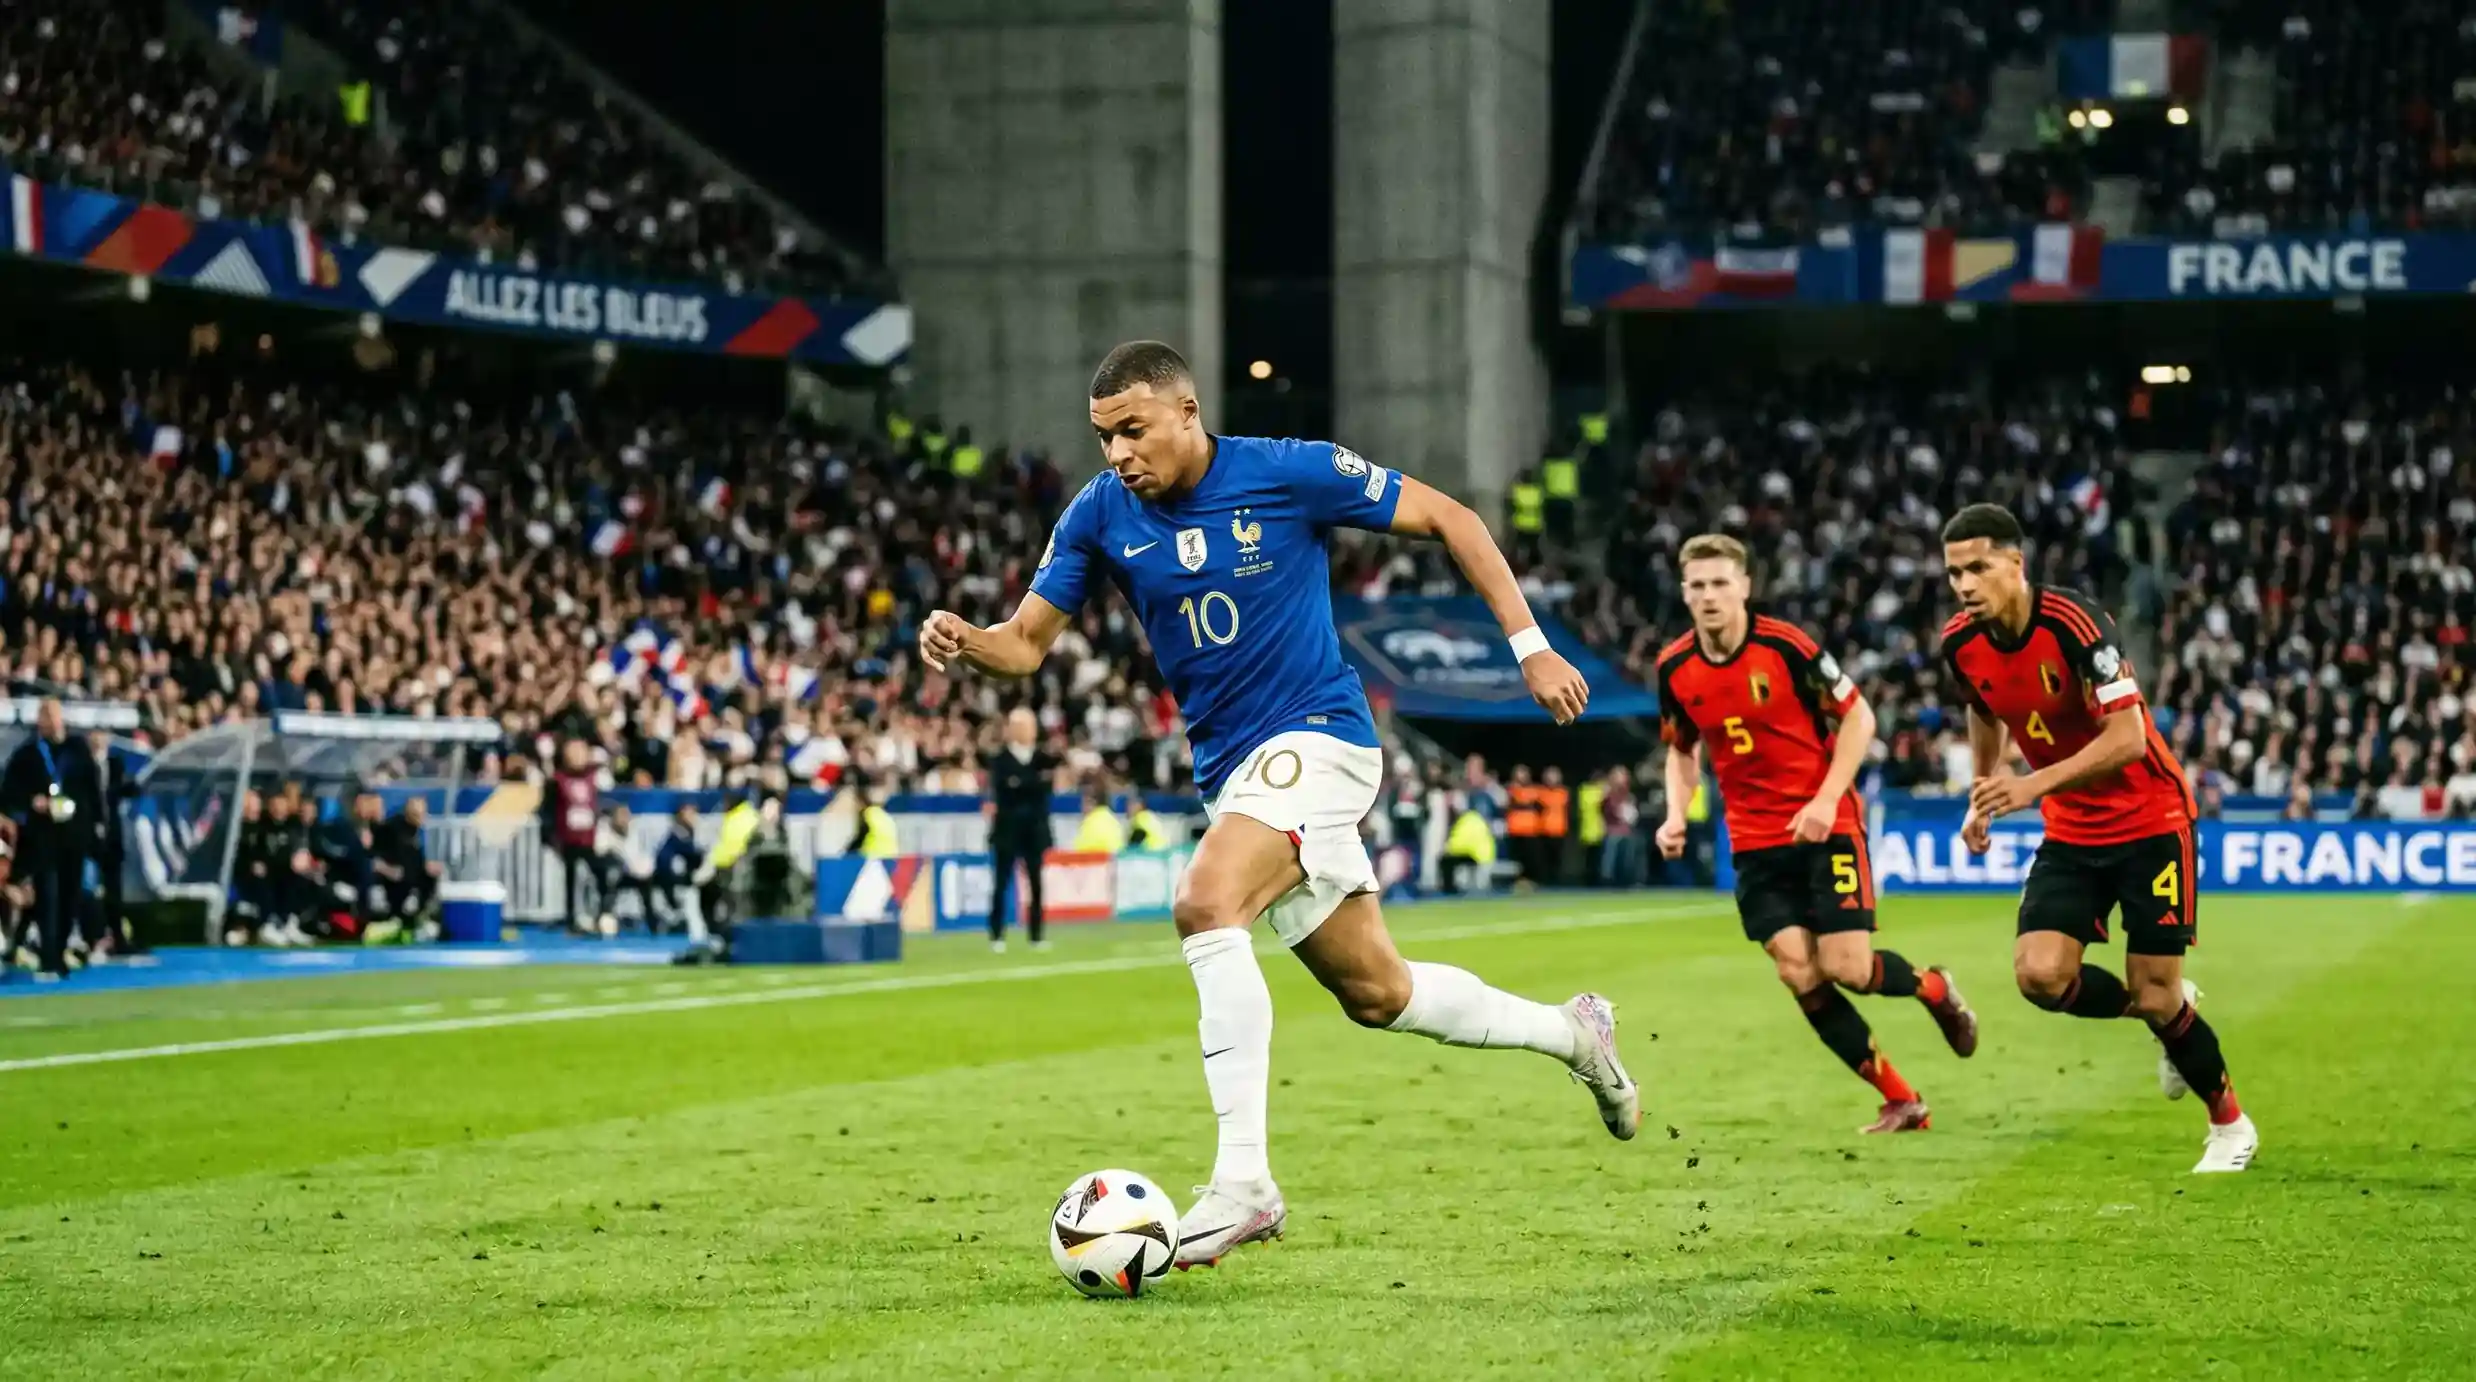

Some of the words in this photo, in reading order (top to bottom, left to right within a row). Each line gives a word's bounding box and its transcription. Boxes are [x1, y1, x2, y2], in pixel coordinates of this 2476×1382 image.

[2168, 240, 2407, 294] FRANCE
[446, 269, 541, 326] ALLEZ
[543, 281, 600, 333] LES
[604, 286, 709, 342] BLEUS
[1179, 591, 1239, 648] 10
[1724, 716, 1754, 754] 5
[2026, 711, 2055, 745] 4
[1832, 854, 1858, 893] 5
[2222, 830, 2476, 884] FRANCE
[2152, 861, 2178, 905] 4
